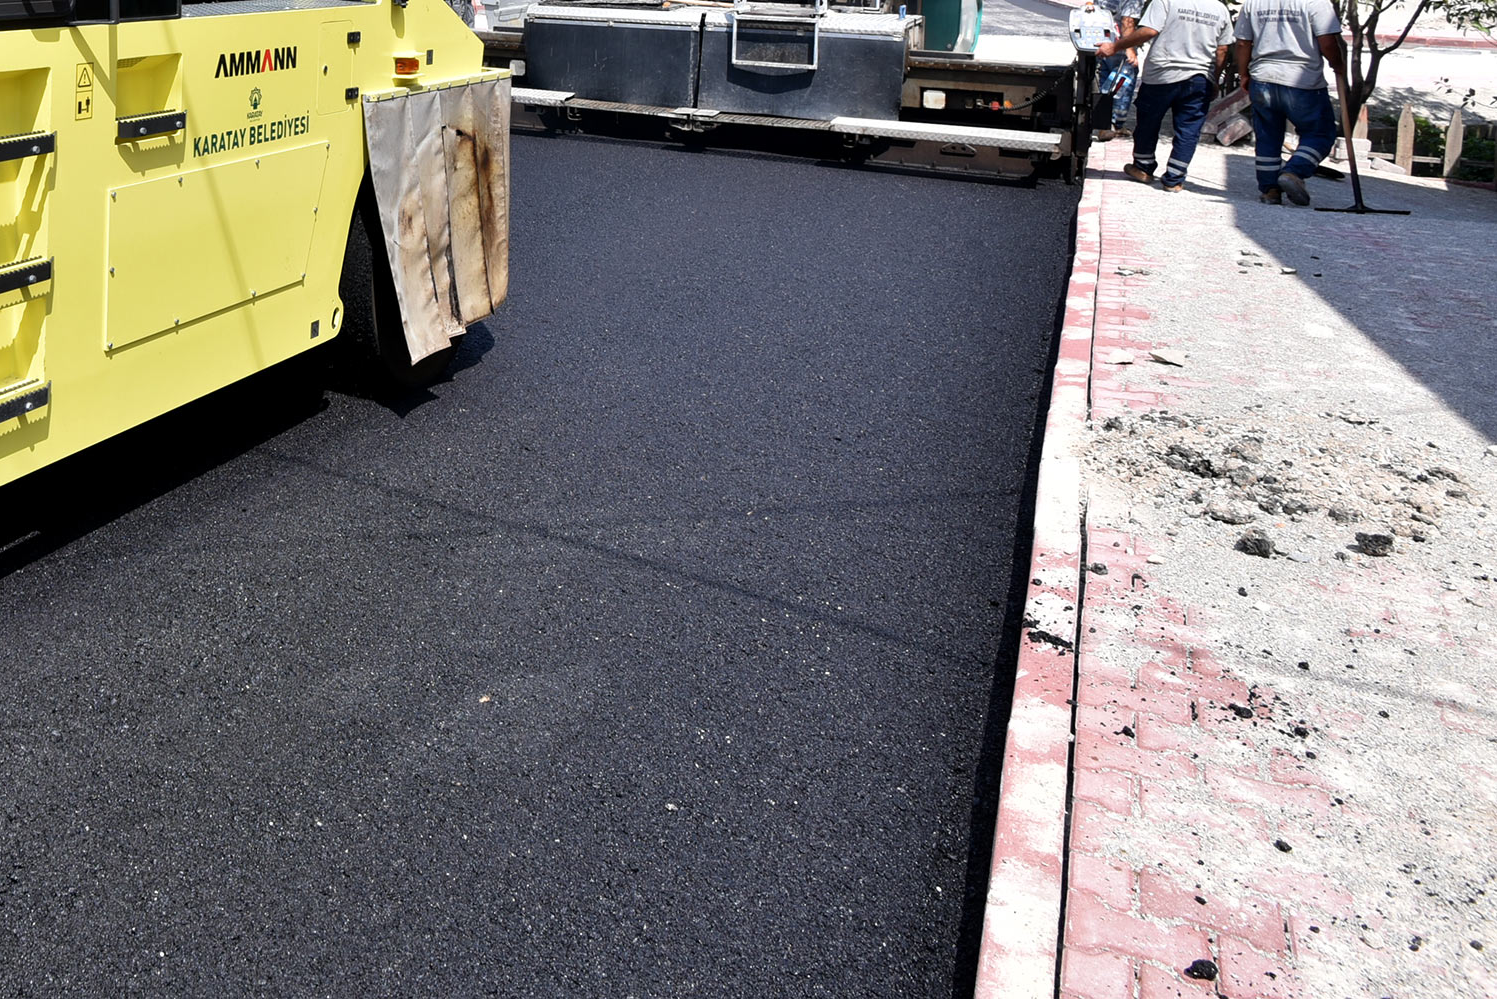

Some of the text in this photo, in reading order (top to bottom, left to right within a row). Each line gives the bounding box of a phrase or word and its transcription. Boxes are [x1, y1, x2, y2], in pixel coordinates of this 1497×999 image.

[214, 46, 297, 79] AMMANN
[193, 109, 310, 158] KARATAY BELEDİYESİ
